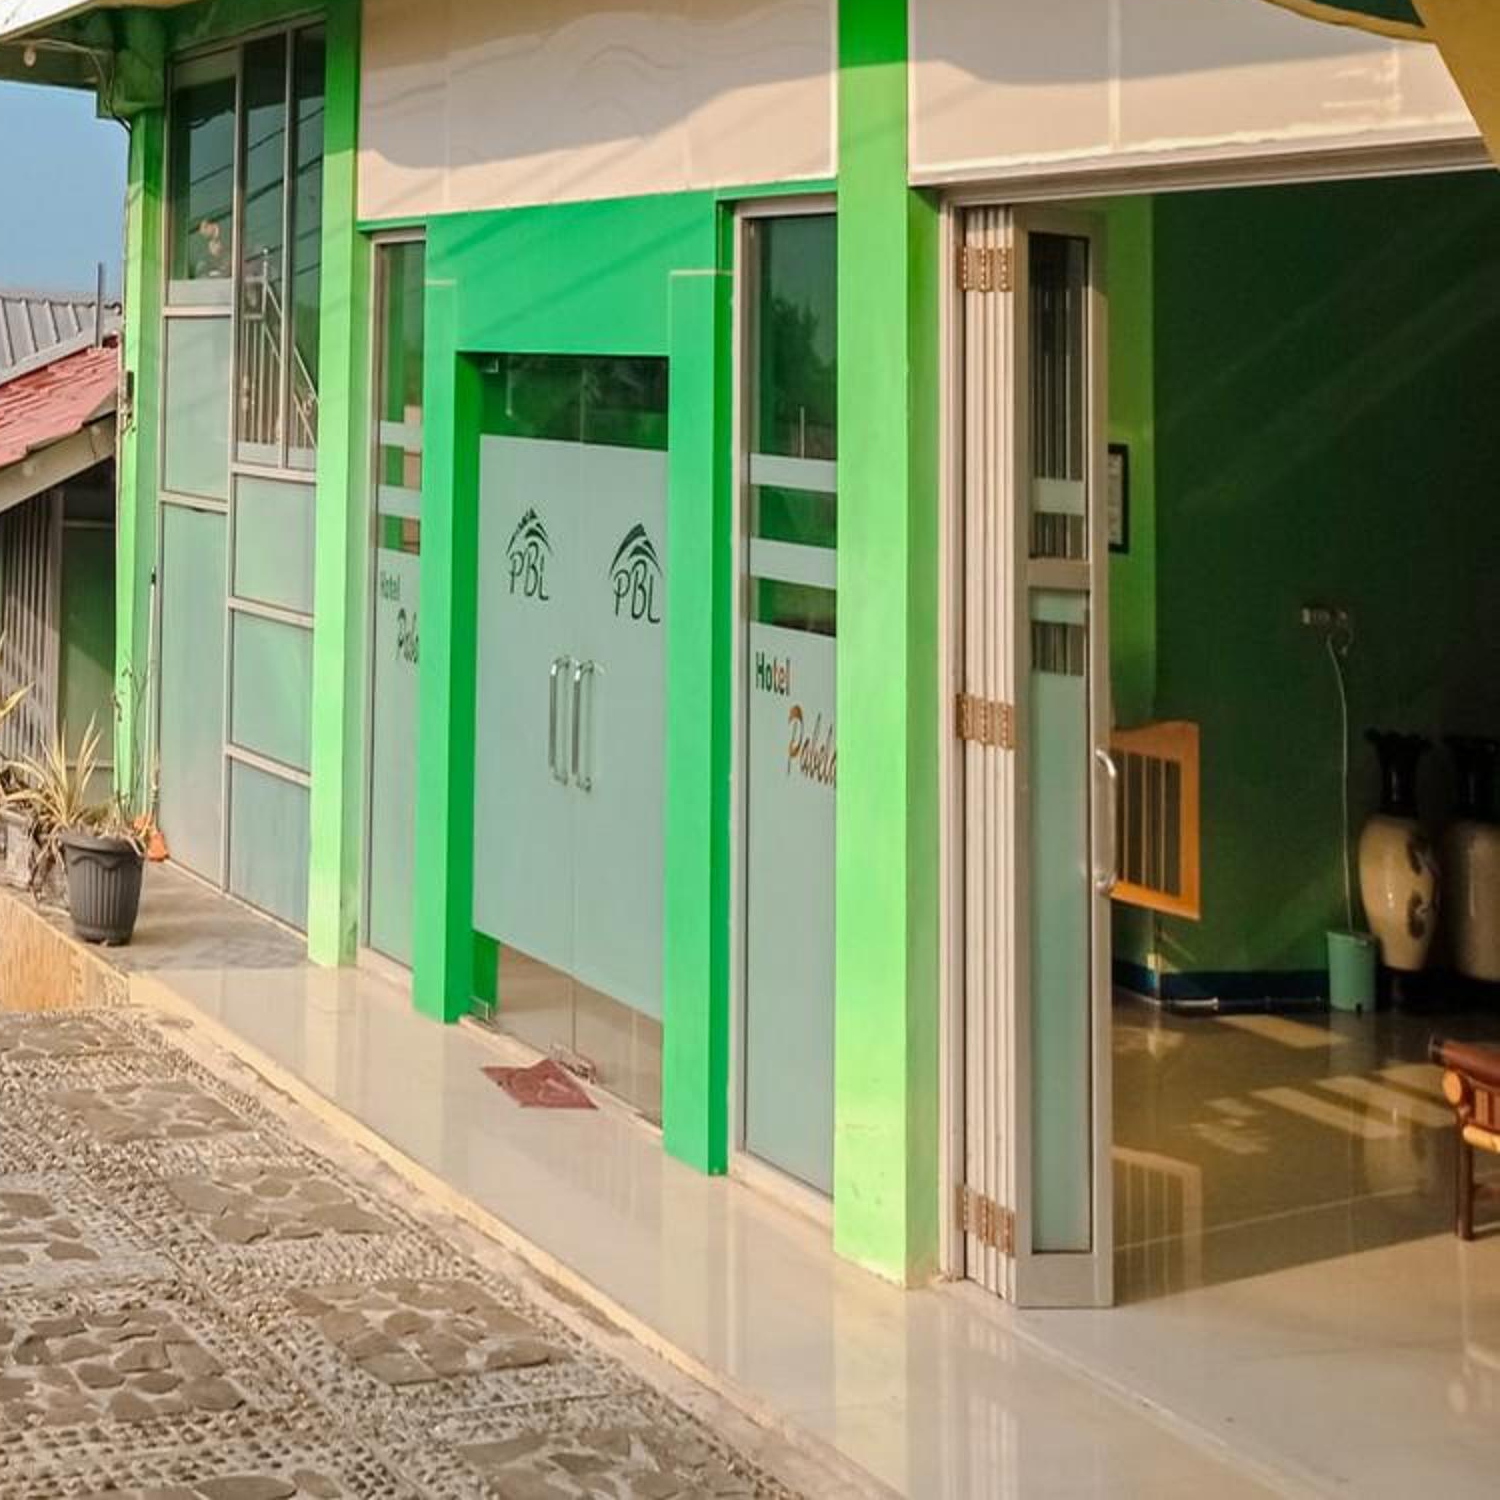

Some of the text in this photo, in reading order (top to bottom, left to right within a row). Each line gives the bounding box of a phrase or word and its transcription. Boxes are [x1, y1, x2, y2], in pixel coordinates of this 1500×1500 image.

[509, 540, 550, 601] PBL
[613, 558, 661, 625] PBL
[755, 651, 791, 696] Hotel
